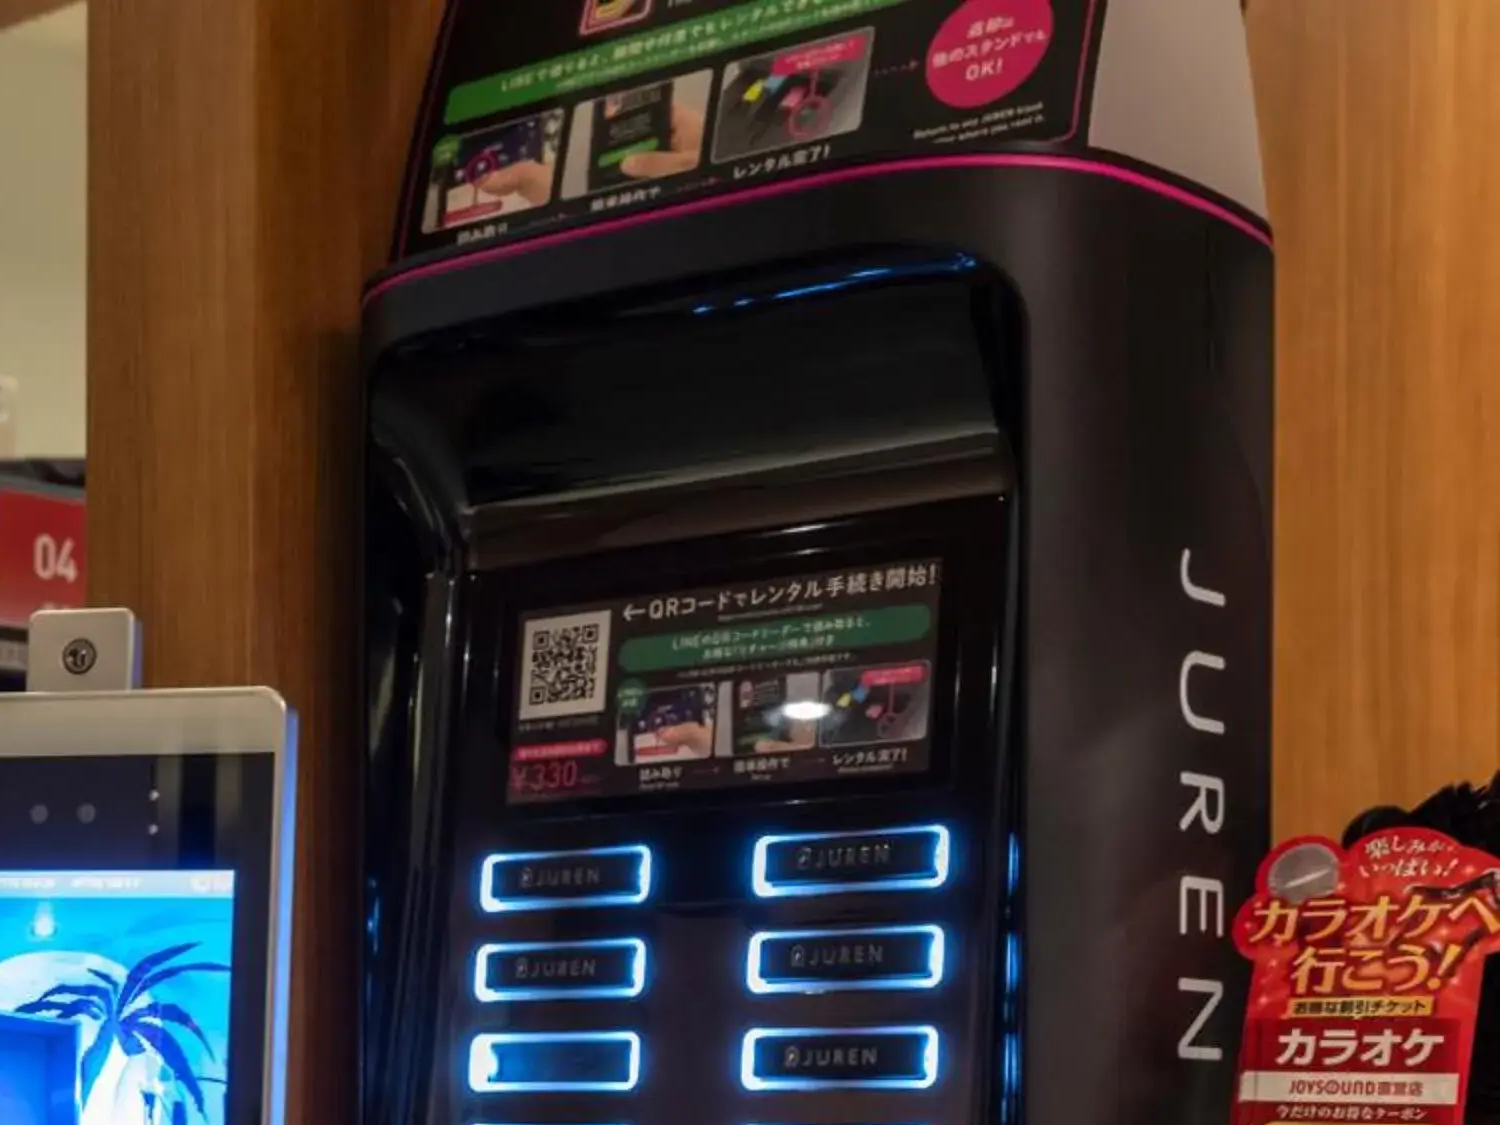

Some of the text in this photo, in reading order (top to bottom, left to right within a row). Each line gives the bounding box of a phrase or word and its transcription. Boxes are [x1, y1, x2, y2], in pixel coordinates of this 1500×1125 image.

[964, 57, 1004, 81] OK!
[33, 532, 79, 583] 04
[649, 563, 937, 620] QRコードでレンタル手続き開始!
[1177, 548, 1227, 1061] JUREN
[537, 868, 600, 887] JUREN
[1250, 895, 1500, 943] カラオケへ
[531, 958, 597, 978] JUREN
[809, 944, 885, 967] JUREN
[1291, 944, 1463, 993] 行こう!
[804, 1047, 878, 1067] JUREN
[1277, 1028, 1445, 1067] カラオケ
